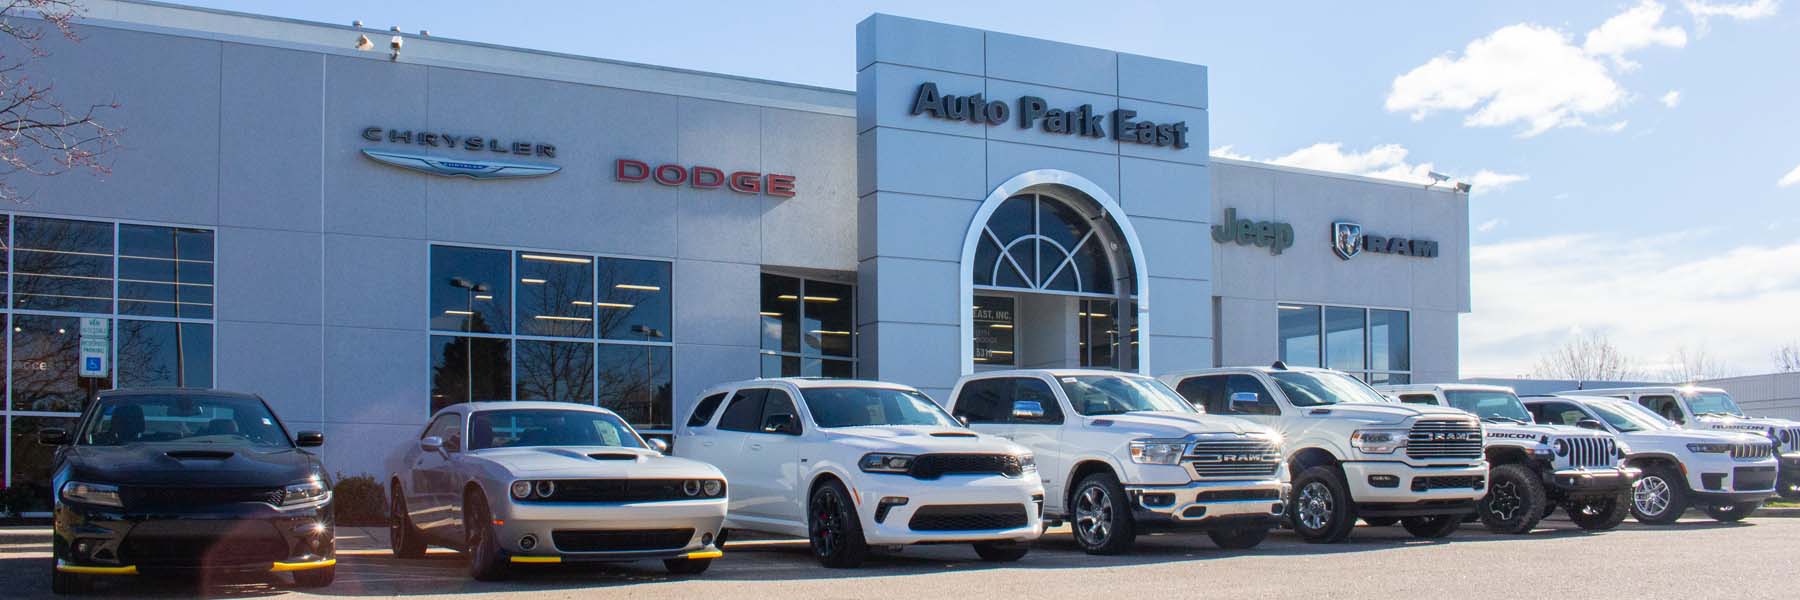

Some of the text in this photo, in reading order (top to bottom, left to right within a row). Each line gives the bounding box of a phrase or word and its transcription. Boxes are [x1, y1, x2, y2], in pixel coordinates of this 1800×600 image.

[911, 82, 1189, 149] Auto Park East
[361, 126, 557, 159] CHRYSLER
[615, 158, 797, 199] DODGE
[1211, 207, 1294, 256] Jeep
[1362, 234, 1439, 258] RAM
[996, 311, 1013, 321] INC.
[1435, 432, 1466, 440] RAM
[1487, 432, 1536, 440] UBICON
[1224, 454, 1261, 462] RAM
